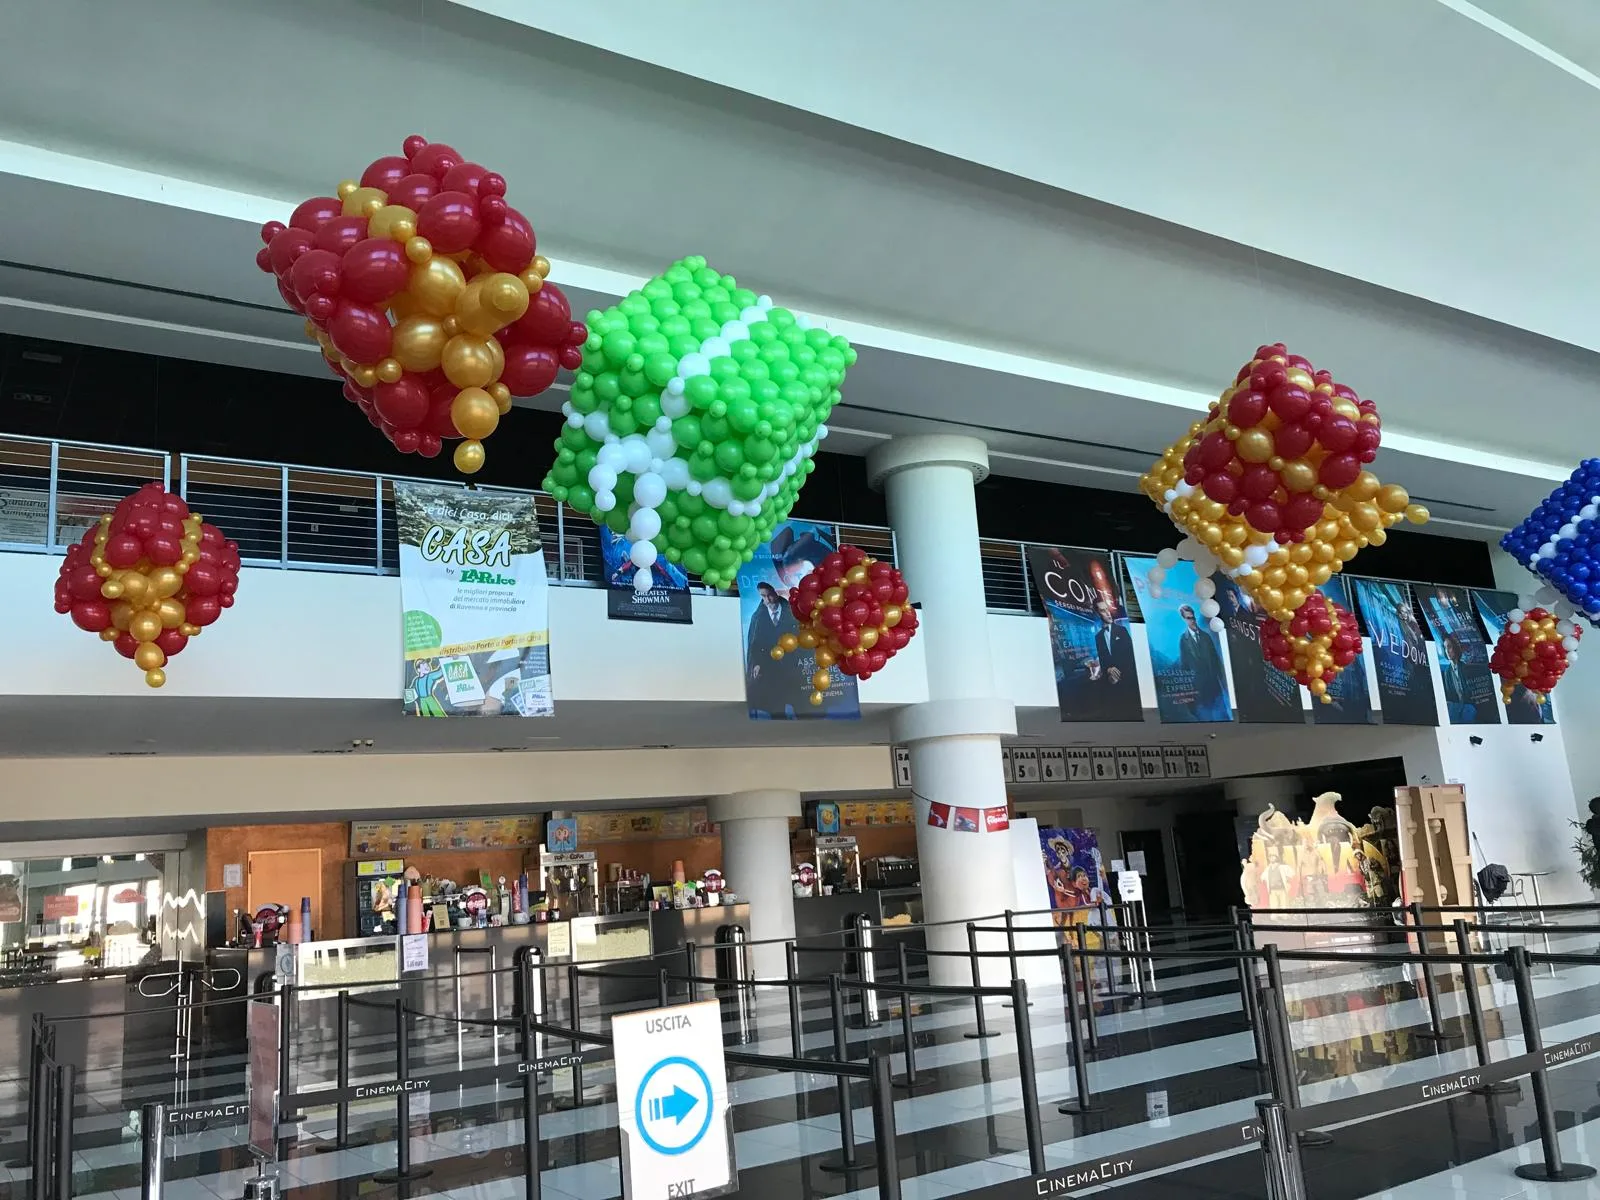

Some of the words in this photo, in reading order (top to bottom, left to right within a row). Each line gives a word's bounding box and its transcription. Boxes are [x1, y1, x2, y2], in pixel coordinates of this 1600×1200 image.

[436, 505, 458, 518] dici
[421, 524, 513, 567] CASA
[446, 567, 455, 575] by
[1053, 559, 1065, 570] IL
[631, 595, 670, 604] SHOWMAN
[1368, 620, 1427, 665] VEDOVA
[807, 674, 846, 684] EESS
[1015, 751, 1036, 759] SALA
[1041, 751, 1063, 759] SALA
[1093, 750, 1113, 758] SALA
[1118, 750, 1137, 758] SALA
[1165, 749, 1183, 757] SALA
[1018, 765, 1026, 778] 5
[1045, 765, 1053, 778] 6
[1071, 764, 1079, 776] 7
[1097, 763, 1104, 776] 8
[1121, 763, 1128, 775] 9
[1143, 762, 1154, 775] 10
[1166, 762, 1177, 774] 11
[1188, 761, 1200, 774] 12
[646, 1014, 692, 1034] USCITA
[518, 1056, 583, 1073] CINEMACITY
[356, 1080, 430, 1097] CINEMACITY
[1422, 1075, 1480, 1098] CINEMACITY
[169, 1105, 249, 1123] CINEMACIT
[1036, 1160, 1133, 1195] CINEMACITY
[667, 1178, 695, 1200] EXIT
